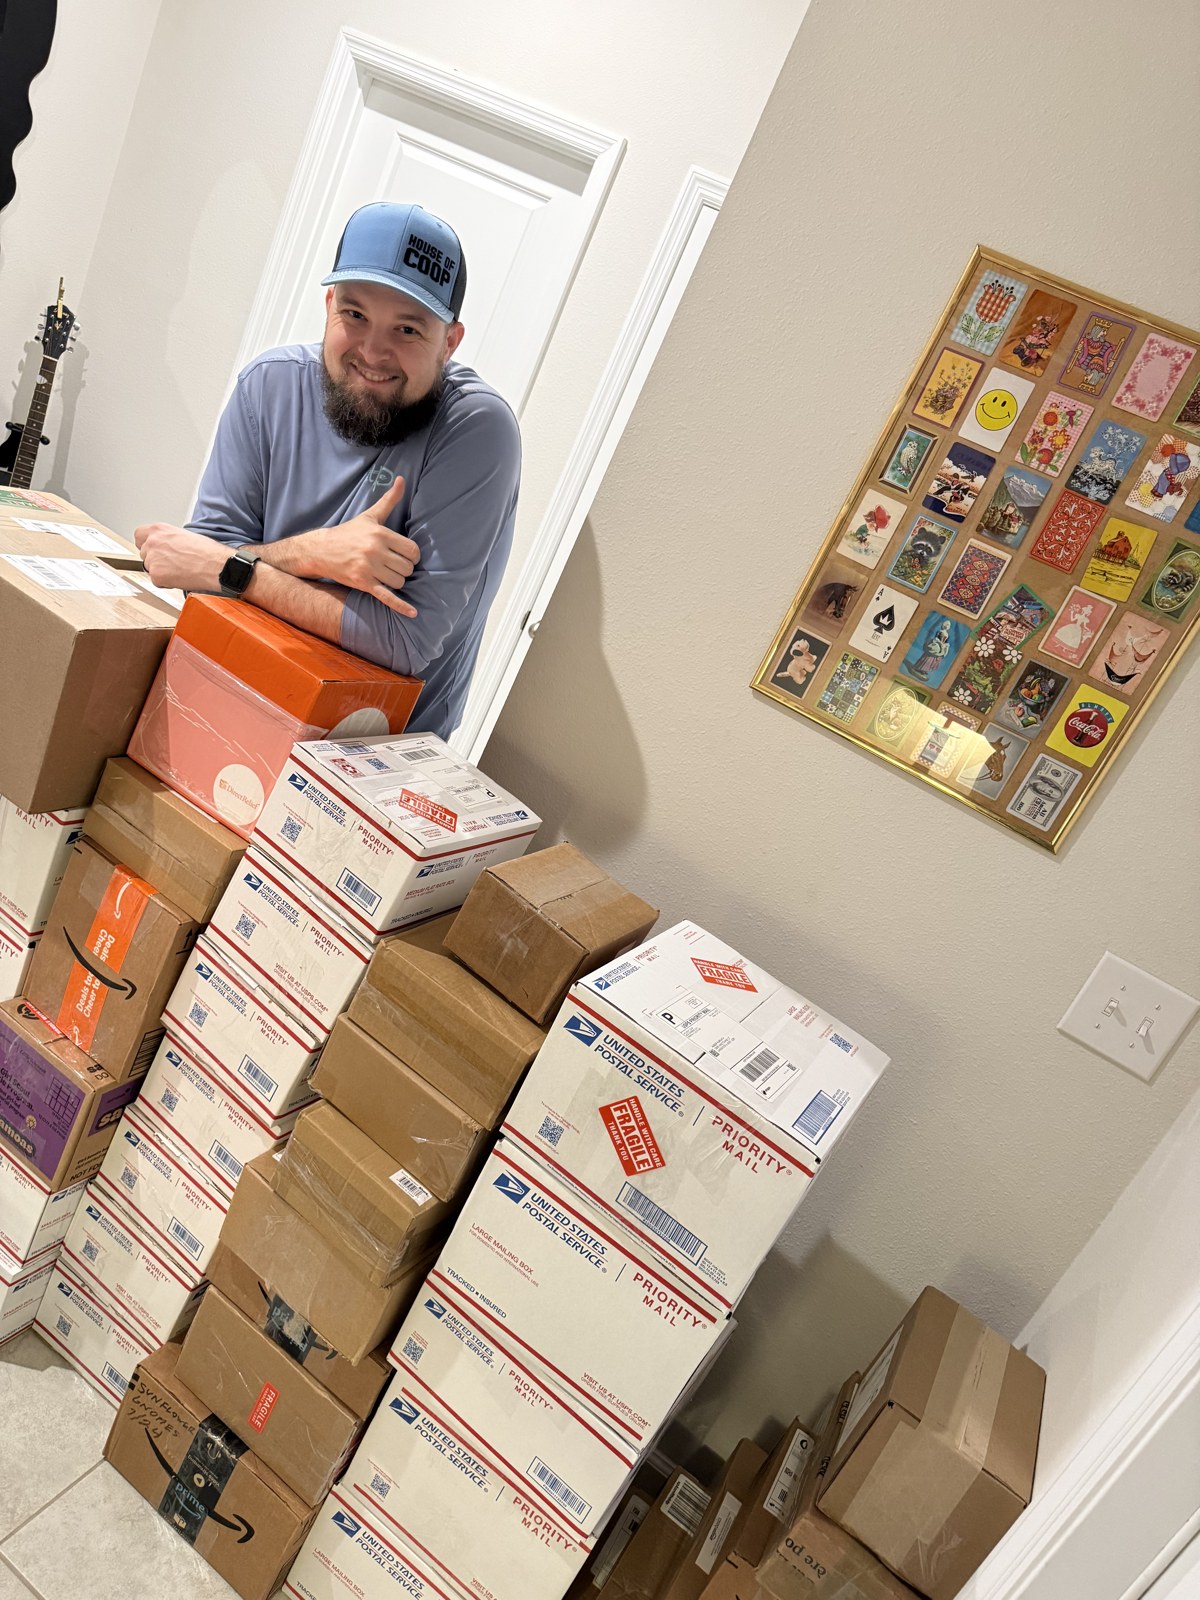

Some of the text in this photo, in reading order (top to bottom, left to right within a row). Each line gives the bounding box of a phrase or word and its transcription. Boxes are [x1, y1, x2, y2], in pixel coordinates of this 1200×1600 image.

[403, 247, 450, 287] COOP
[408, 234, 455, 270] HOUSE OF
[877, 588, 884, 597] A
[302, 789, 321, 809] POSTAL
[307, 783, 328, 804] UNITED
[327, 801, 347, 817] STATES
[402, 794, 454, 826] FRAGILE
[16, 807, 37, 830] MAIL
[357, 825, 392, 856] PRIORITY
[362, 838, 379, 855] MAIL
[257, 889, 277, 910] POSTAL
[262, 883, 283, 903] UNITED
[281, 898, 300, 918] STATES
[100, 934, 115, 962] Deals
[310, 926, 342, 957] PRIORITY
[314, 939, 330, 956] MAIL
[275, 962, 288, 975] VISIT
[287, 972, 295, 981] US
[700, 966, 750, 984] FRAGILE
[76, 986, 89, 1012] Deals
[84, 990, 95, 1018] Cheer
[208, 979, 226, 999] POSTAL
[212, 973, 248, 1007] UNITED STATES
[256, 1015, 286, 1046] PRIORITY
[661, 1012, 676, 1025] P
[260, 1027, 276, 1044] MAIL
[178, 1066, 195, 1085] POSTAL
[182, 1061, 216, 1095] UNITED STATES
[593, 1044, 682, 1112] POSTAL SERVICE
[603, 1034, 685, 1098] UNITED STATES
[223, 1101, 253, 1132] PRIORITY
[227, 1113, 243, 1131] MAIL
[607, 1121, 629, 1161] THANK YOU
[612, 1104, 651, 1170] FRAGILE
[629, 1098, 662, 1168] HANDLE WITH CARE
[711, 1115, 787, 1174] PRIORITY
[136, 1146, 153, 1165] POSTAL
[140, 1141, 173, 1174] UNITED STATES
[722, 1140, 758, 1174] MAIL
[14, 1176, 27, 1190] MAIL
[70, 1168, 87, 1182] NOT
[181, 1181, 210, 1211] PRIORITY
[185, 1192, 201, 1209] MAIL
[98, 1220, 115, 1239] POSTAL
[101, 1215, 134, 1248] UNITED STATES
[522, 1202, 605, 1269] POSTAL SERVICE
[530, 1192, 571, 1227] UNITED
[568, 1223, 608, 1255] STATES
[471, 1222, 534, 1276] LARGE MAILING BOX
[141, 1254, 169, 1283] PRIORITY
[145, 1266, 160, 1282] MAIL
[69, 1296, 86, 1313] POSTAL
[72, 1291, 104, 1322] UNITED STATES
[446, 1266, 508, 1319] TRACKED INSURED
[632, 1272, 703, 1328] PRIORITY
[642, 1294, 676, 1327] MAIL
[116, 1339, 131, 1354] MAIL
[441, 1318, 493, 1366] POSTAL SERVICE
[447, 1313, 495, 1357] UNITED STATES
[508, 1369, 551, 1409] PRIORITY
[514, 1385, 535, 1407] MAIL
[583, 1372, 649, 1427] VISIT US AT USPS.COM
[132, 1395, 181, 1438] GNOMES
[254, 1389, 277, 1429] FRAGILE
[414, 1424, 487, 1489] POSTAL SERVICE
[421, 1417, 489, 1477] UNITED STATES
[175, 1481, 206, 1515] prime
[512, 1496, 573, 1551] PRIORITY
[521, 1517, 551, 1548] MAIL
[314, 1547, 333, 1567] LARGE
[331, 1564, 354, 1587] MAILING
[352, 1583, 366, 1598] BOX
[355, 1537, 386, 1569] POSTAL
[385, 1565, 424, 1600] SERVICE
[361, 1531, 395, 1562] UNITED
[392, 1560, 425, 1591] STATES
[472, 1577, 487, 1591] VISIT
